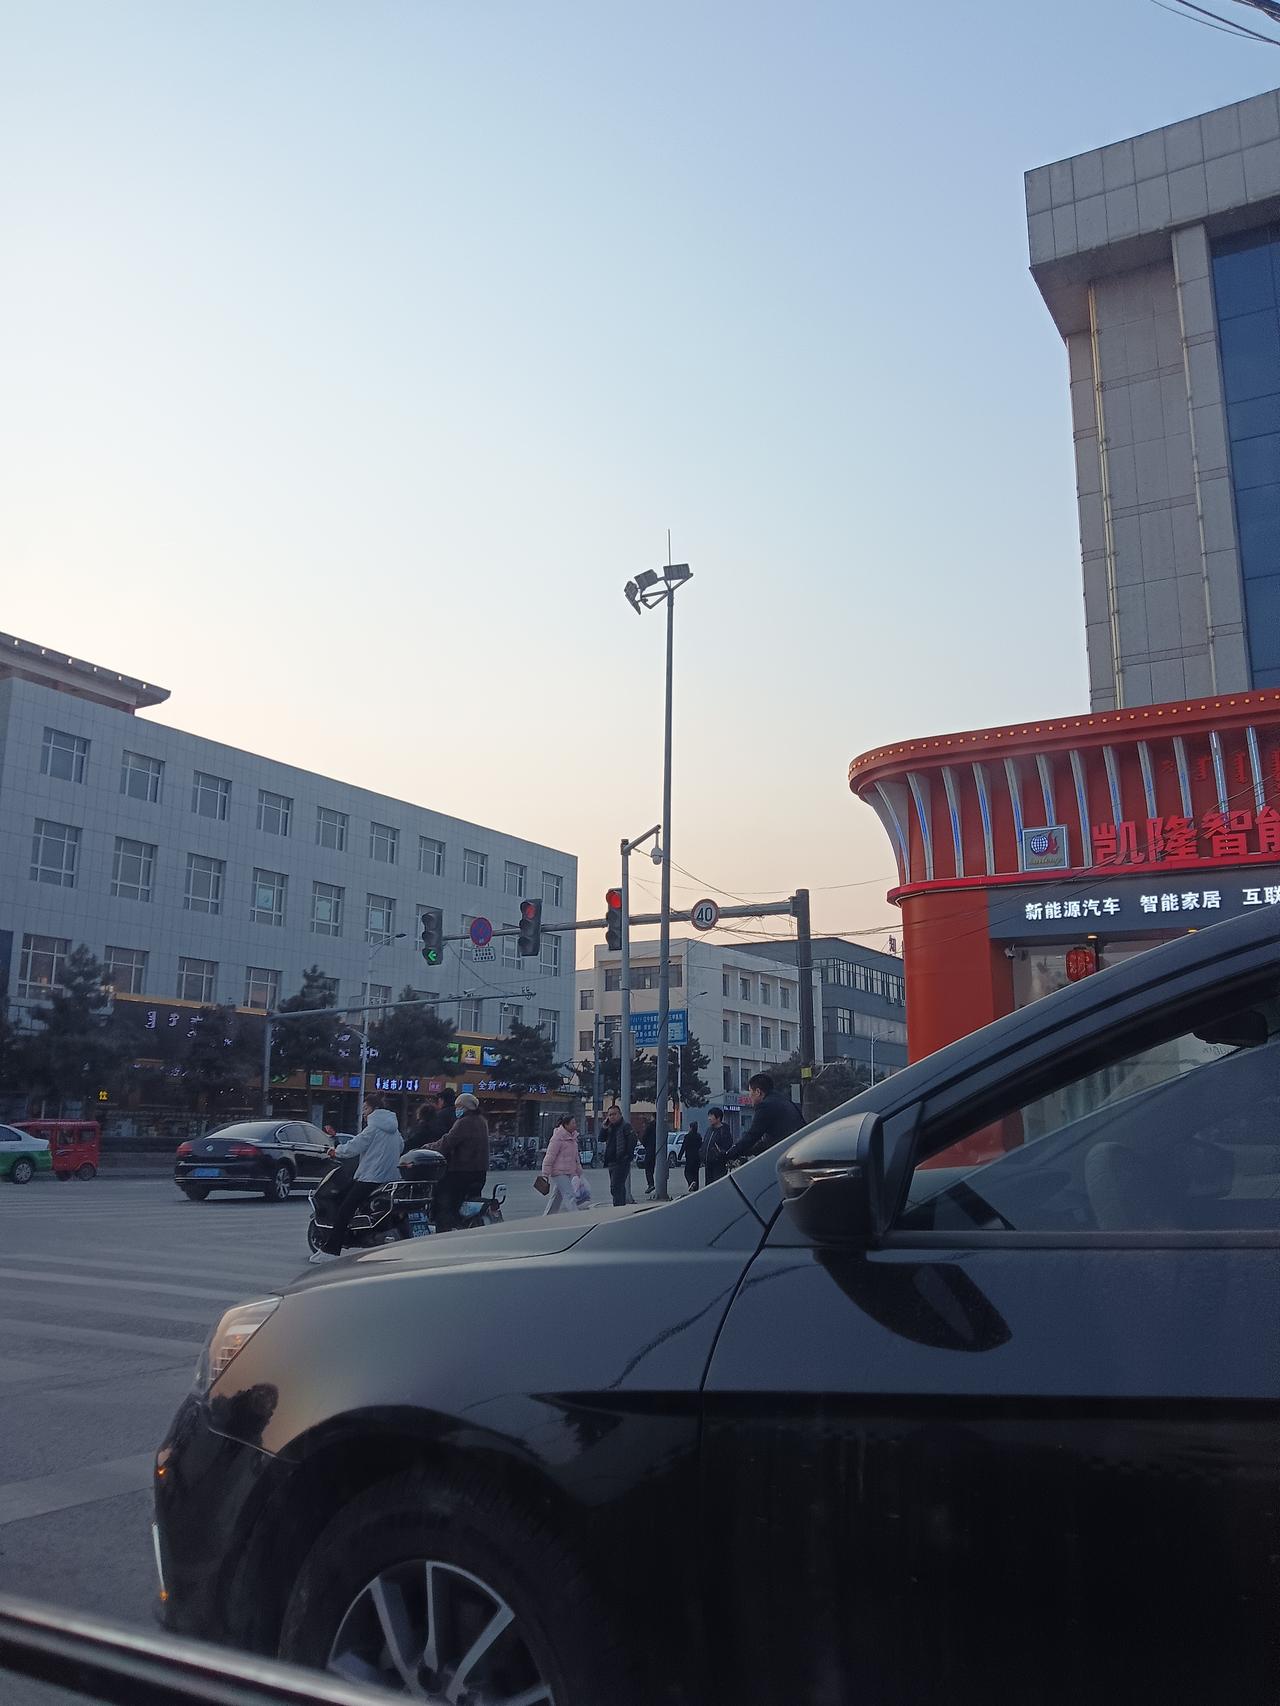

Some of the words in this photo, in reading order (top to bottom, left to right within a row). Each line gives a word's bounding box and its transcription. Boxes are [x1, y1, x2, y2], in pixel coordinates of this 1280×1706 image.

[696, 906, 713, 922] 40
[1025, 897, 1120, 920] 新能源汽车
[1140, 890, 1222, 913] 智能家居
